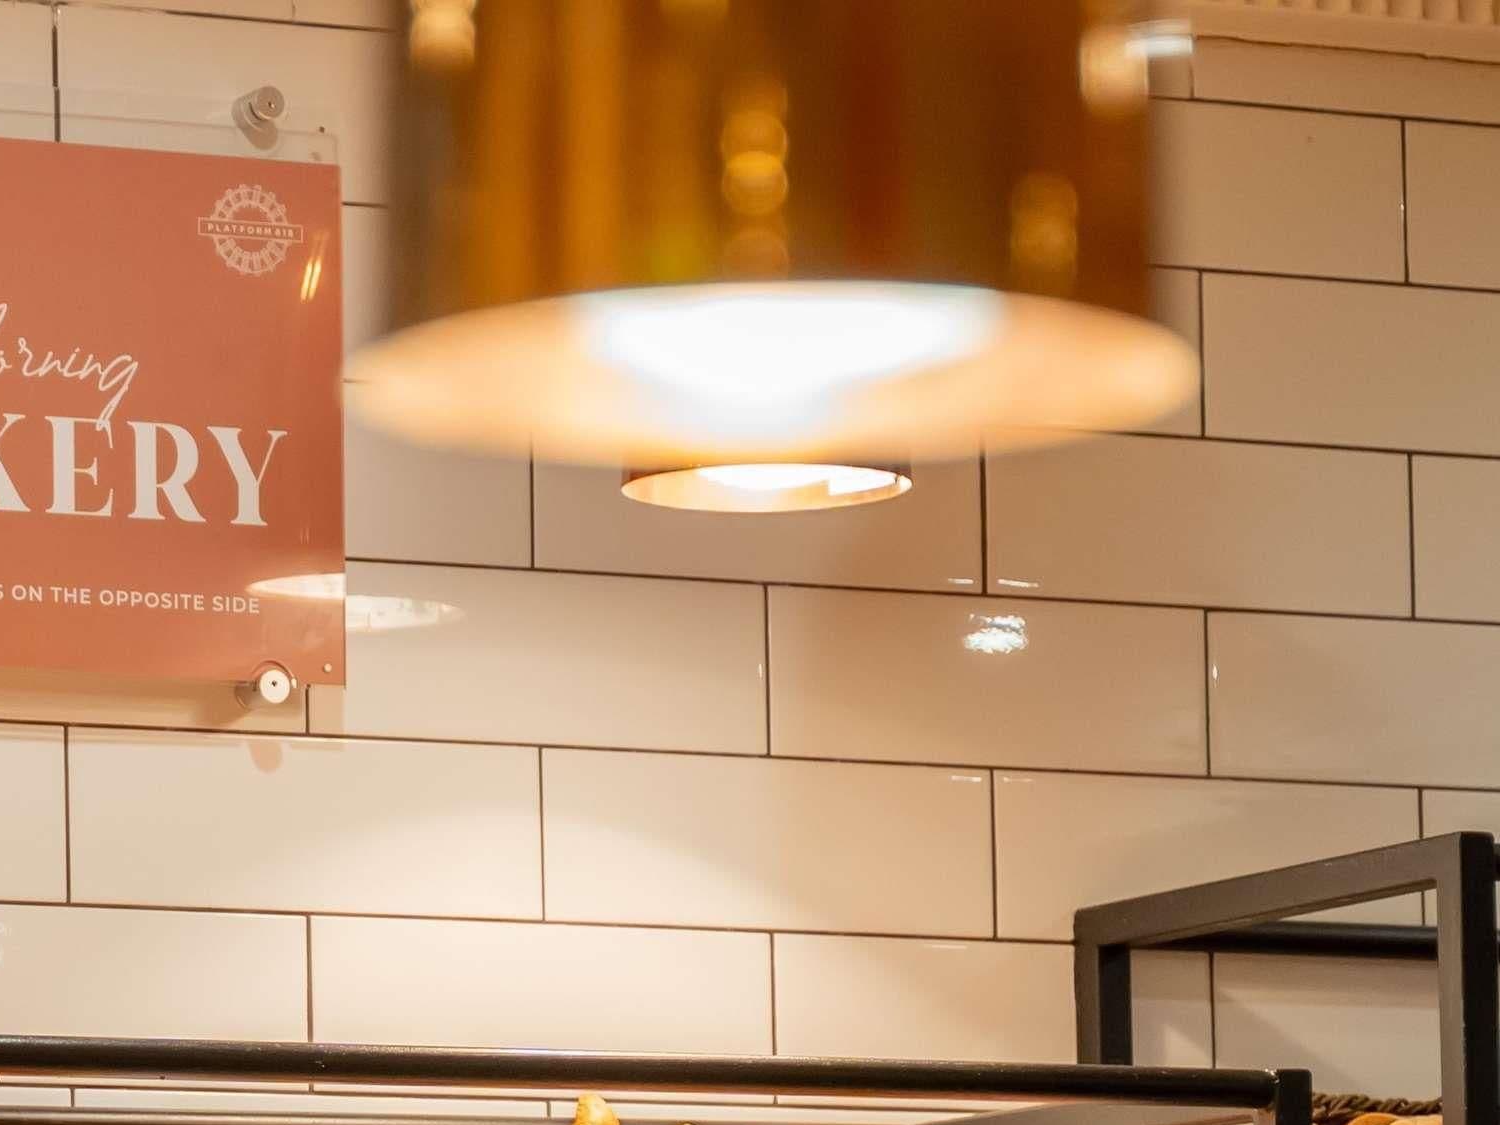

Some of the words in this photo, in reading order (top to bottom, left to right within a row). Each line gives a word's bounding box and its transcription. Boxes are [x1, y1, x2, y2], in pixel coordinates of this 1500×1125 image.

[207, 222, 273, 235] PLATFORM
[11, 584, 43, 602] ON
[50, 586, 92, 605] THE
[99, 589, 205, 611] OPPOSITE
[212, 595, 260, 614] SIDE
